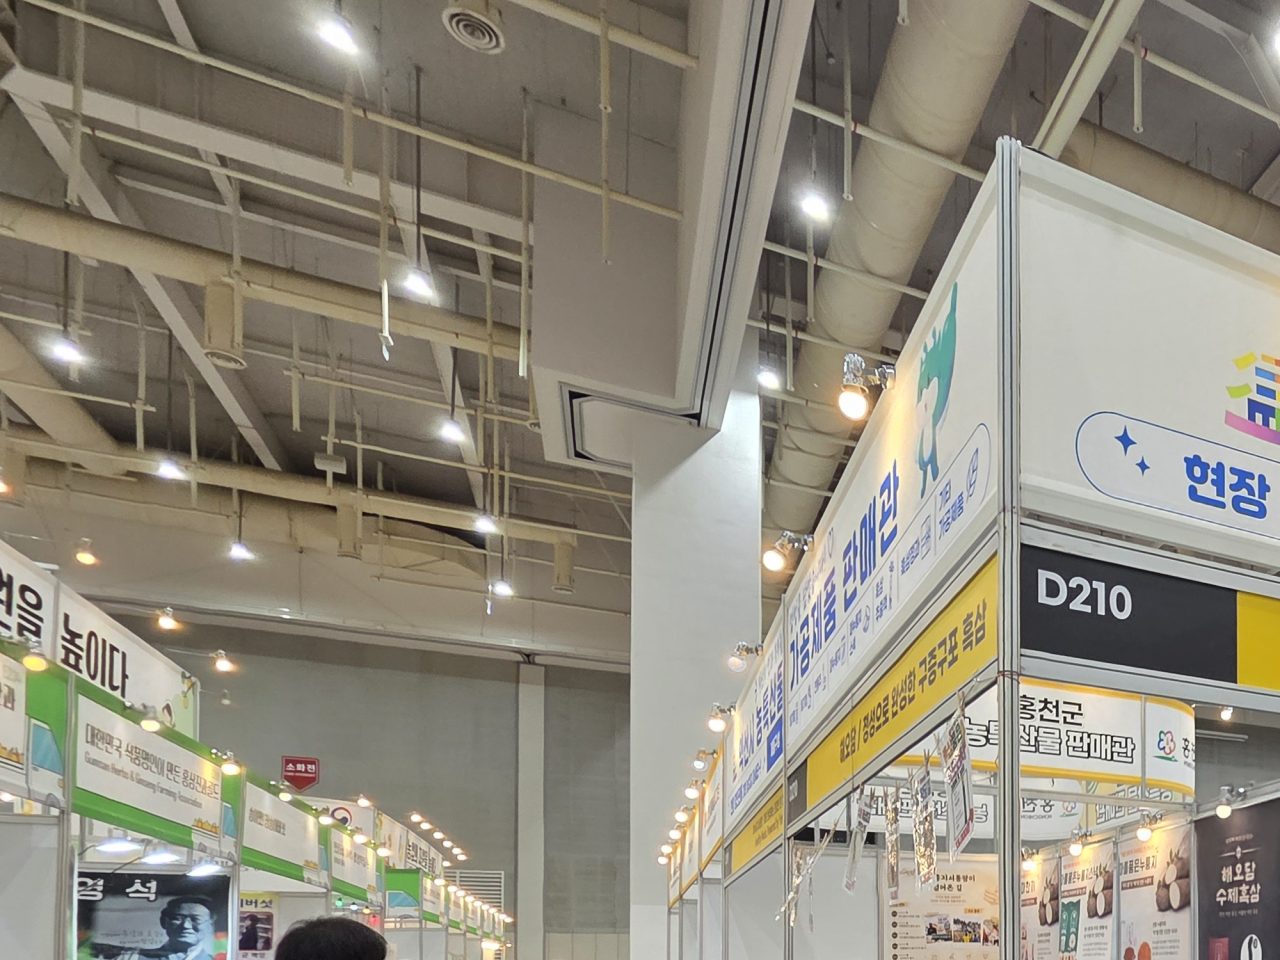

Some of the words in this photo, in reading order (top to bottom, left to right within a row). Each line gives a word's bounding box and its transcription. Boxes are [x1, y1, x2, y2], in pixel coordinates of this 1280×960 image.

[1184, 454, 1270, 519] 현장
[843, 458, 899, 613] 판매관
[1036, 569, 1132, 620] D210
[790, 566, 836, 691] 가공제품
[61, 612, 128, 699] 높이다
[862, 700, 890, 744] 정성으로
[918, 626, 959, 693] 구증구포
[962, 598, 987, 653] 흑삼
[1019, 694, 1083, 726] 홍천군
[285, 763, 316, 772] 소화전
[1066, 730, 1135, 764] 판매관
[1216, 883, 1261, 906] 수제흑삼
[1221, 862, 1256, 883] 해오담
